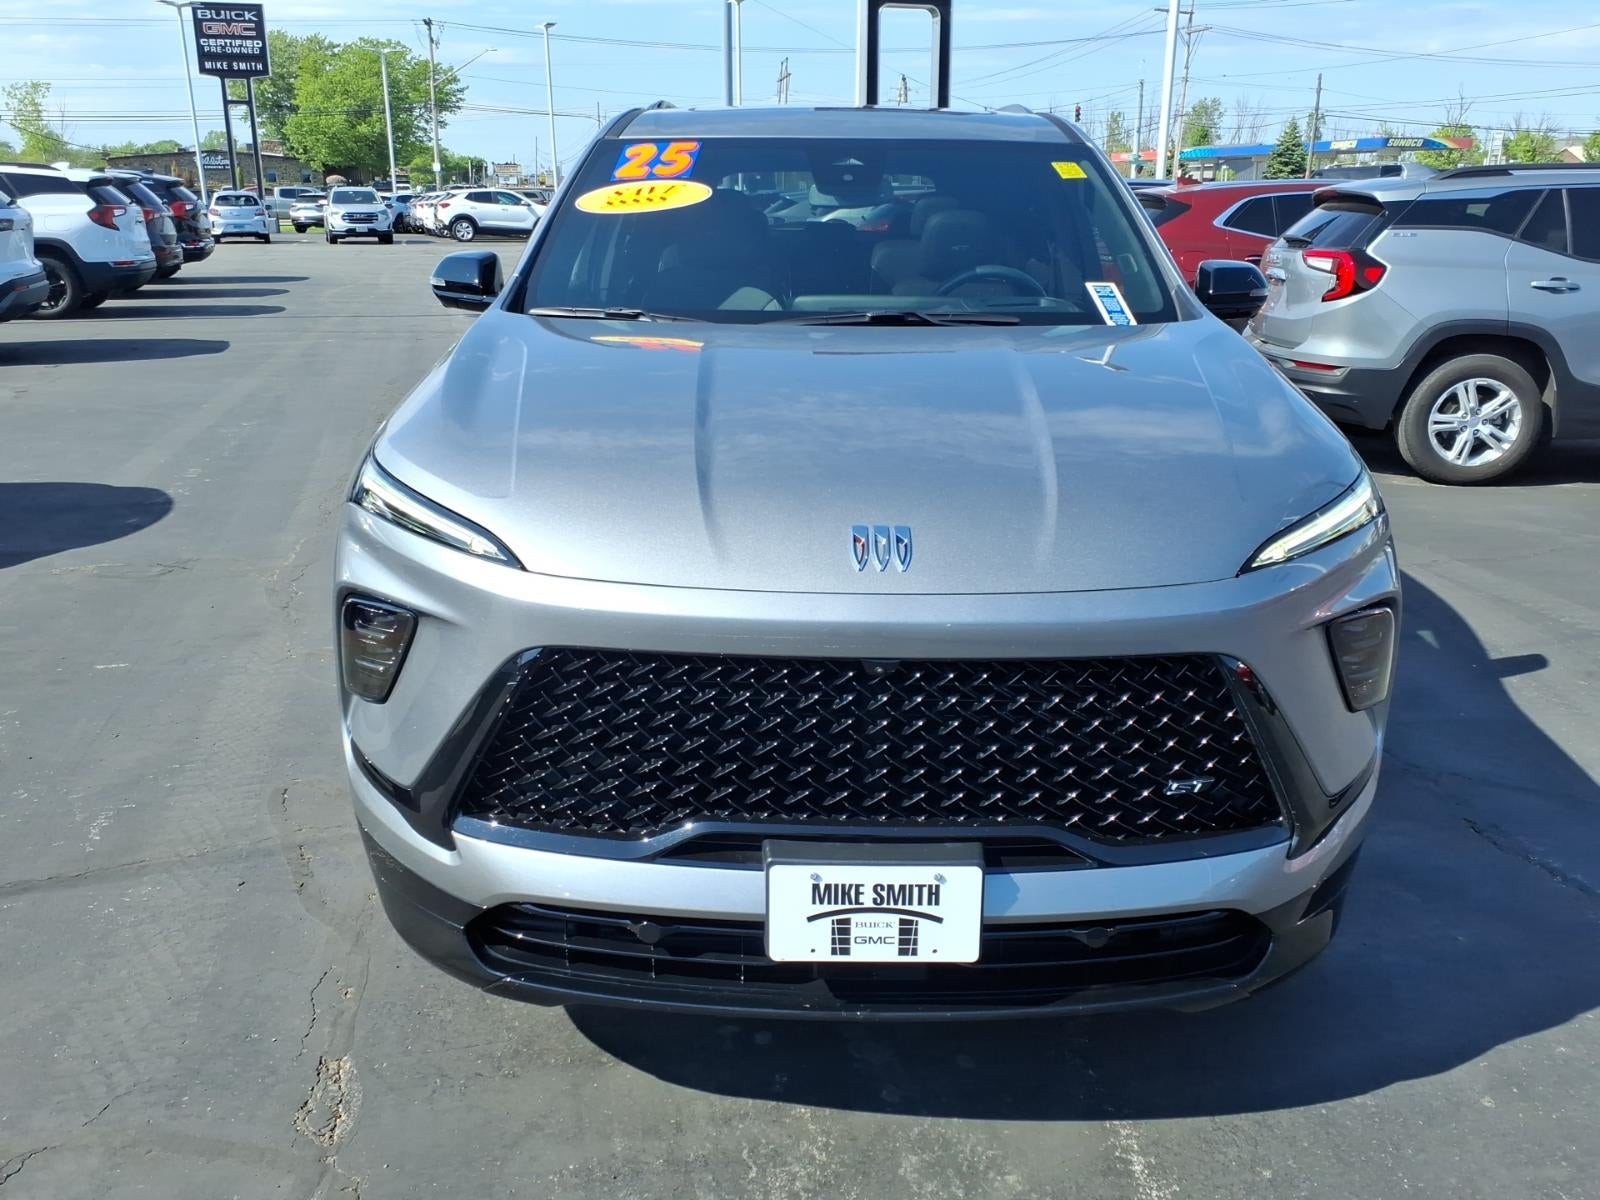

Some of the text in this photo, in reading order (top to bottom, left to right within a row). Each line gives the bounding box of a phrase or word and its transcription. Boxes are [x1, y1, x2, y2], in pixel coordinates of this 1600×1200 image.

[197, 9, 258, 21] BUICK
[203, 22, 256, 36] GMC
[200, 38, 262, 48] CERTIFIED
[204, 46, 260, 54] PRE-OWNED
[204, 61, 263, 71] MIKE SMITH
[1386, 138, 1424, 147] SUNOCO
[614, 141, 700, 180] 25
[811, 883, 941, 907] MIKE SMITH
[855, 921, 894, 929] BUICK
[854, 936, 896, 945] GMC
